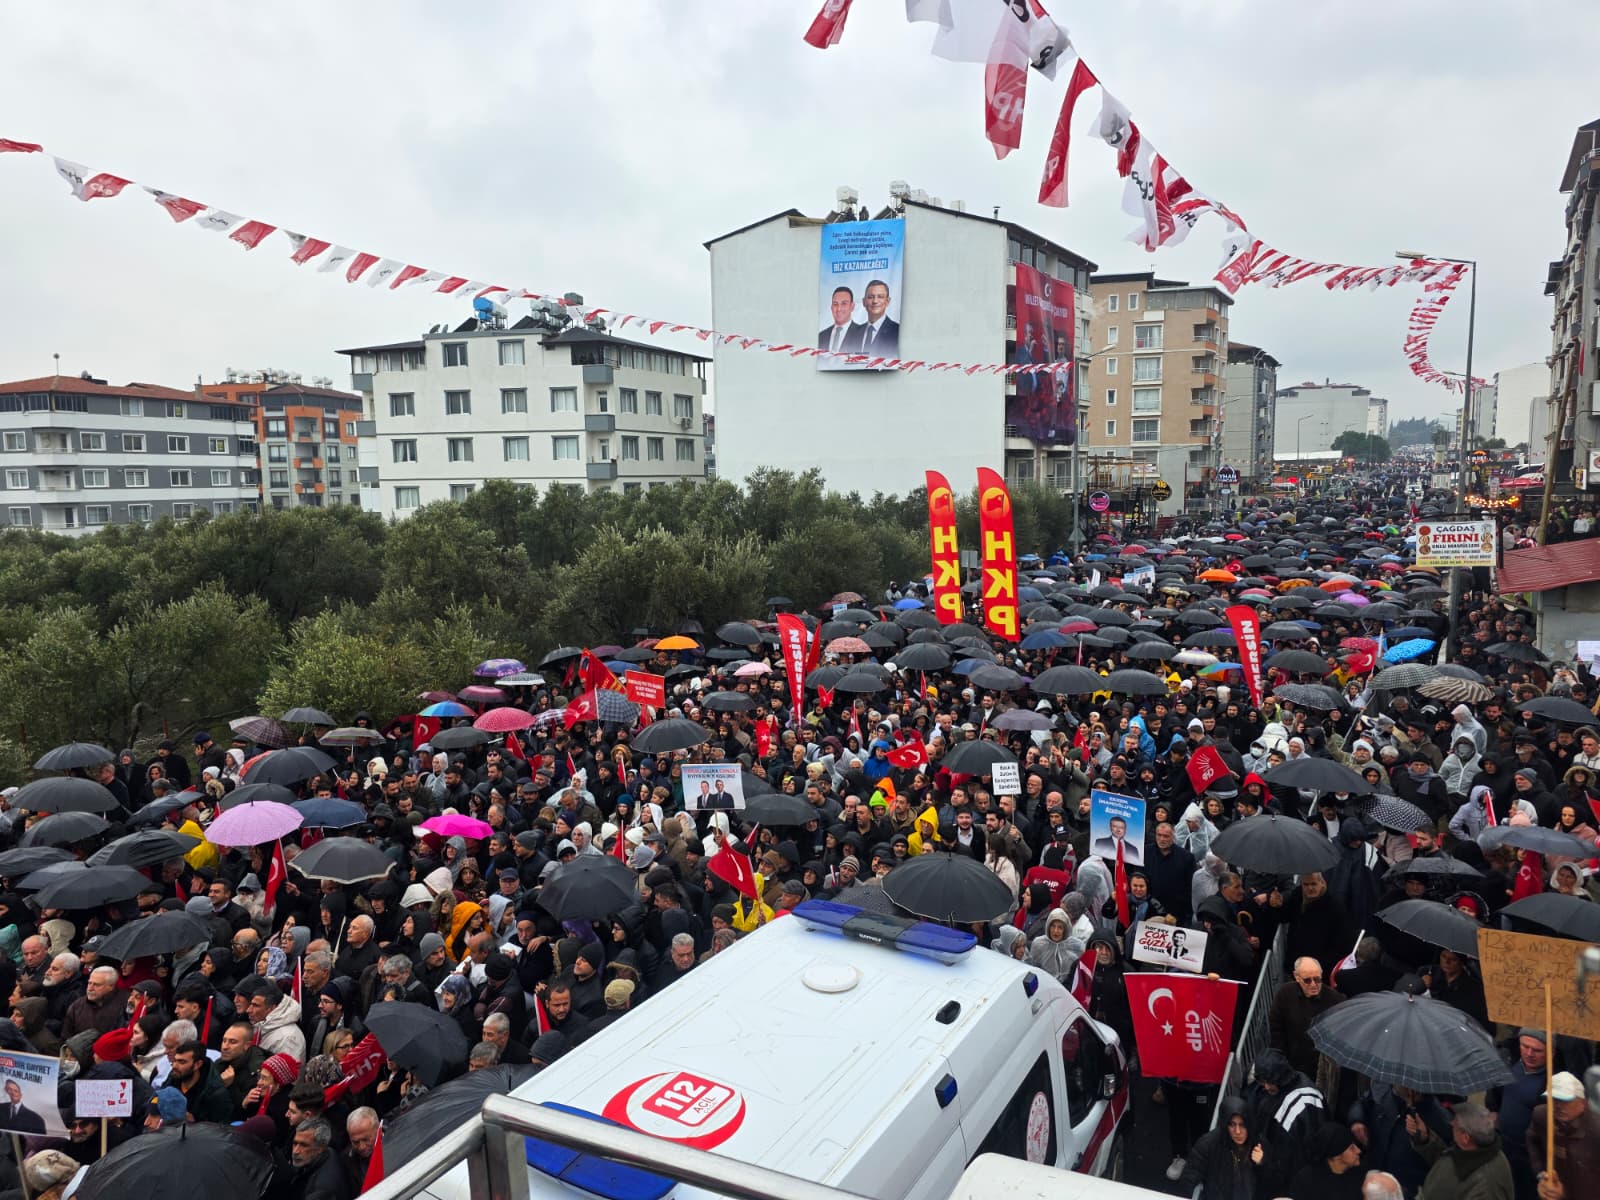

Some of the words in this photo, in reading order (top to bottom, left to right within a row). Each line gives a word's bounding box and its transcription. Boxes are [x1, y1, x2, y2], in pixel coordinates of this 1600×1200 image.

[1433, 532, 1480, 543] FIRINI
[1240, 620, 1262, 691] MERSİN
[1185, 1009, 1203, 1052] CHP
[654, 1080, 707, 1111] 112
